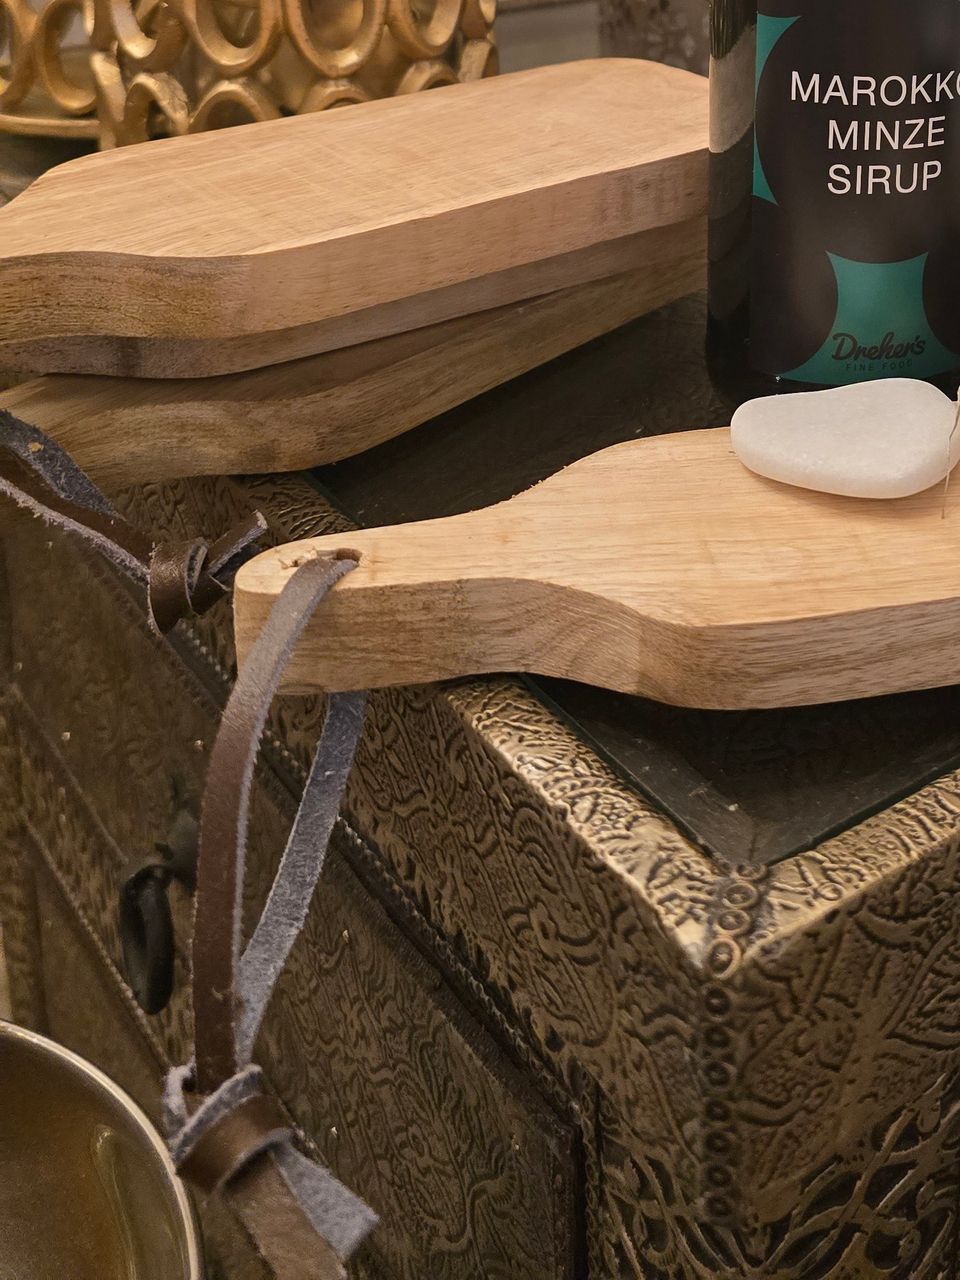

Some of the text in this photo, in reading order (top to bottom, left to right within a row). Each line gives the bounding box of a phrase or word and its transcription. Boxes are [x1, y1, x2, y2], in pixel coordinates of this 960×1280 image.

[827, 115, 946, 151] MINZE
[827, 160, 942, 195] SIRUP
[832, 331, 927, 361] Dreher's
[846, 360, 913, 372] FINE FOOD
